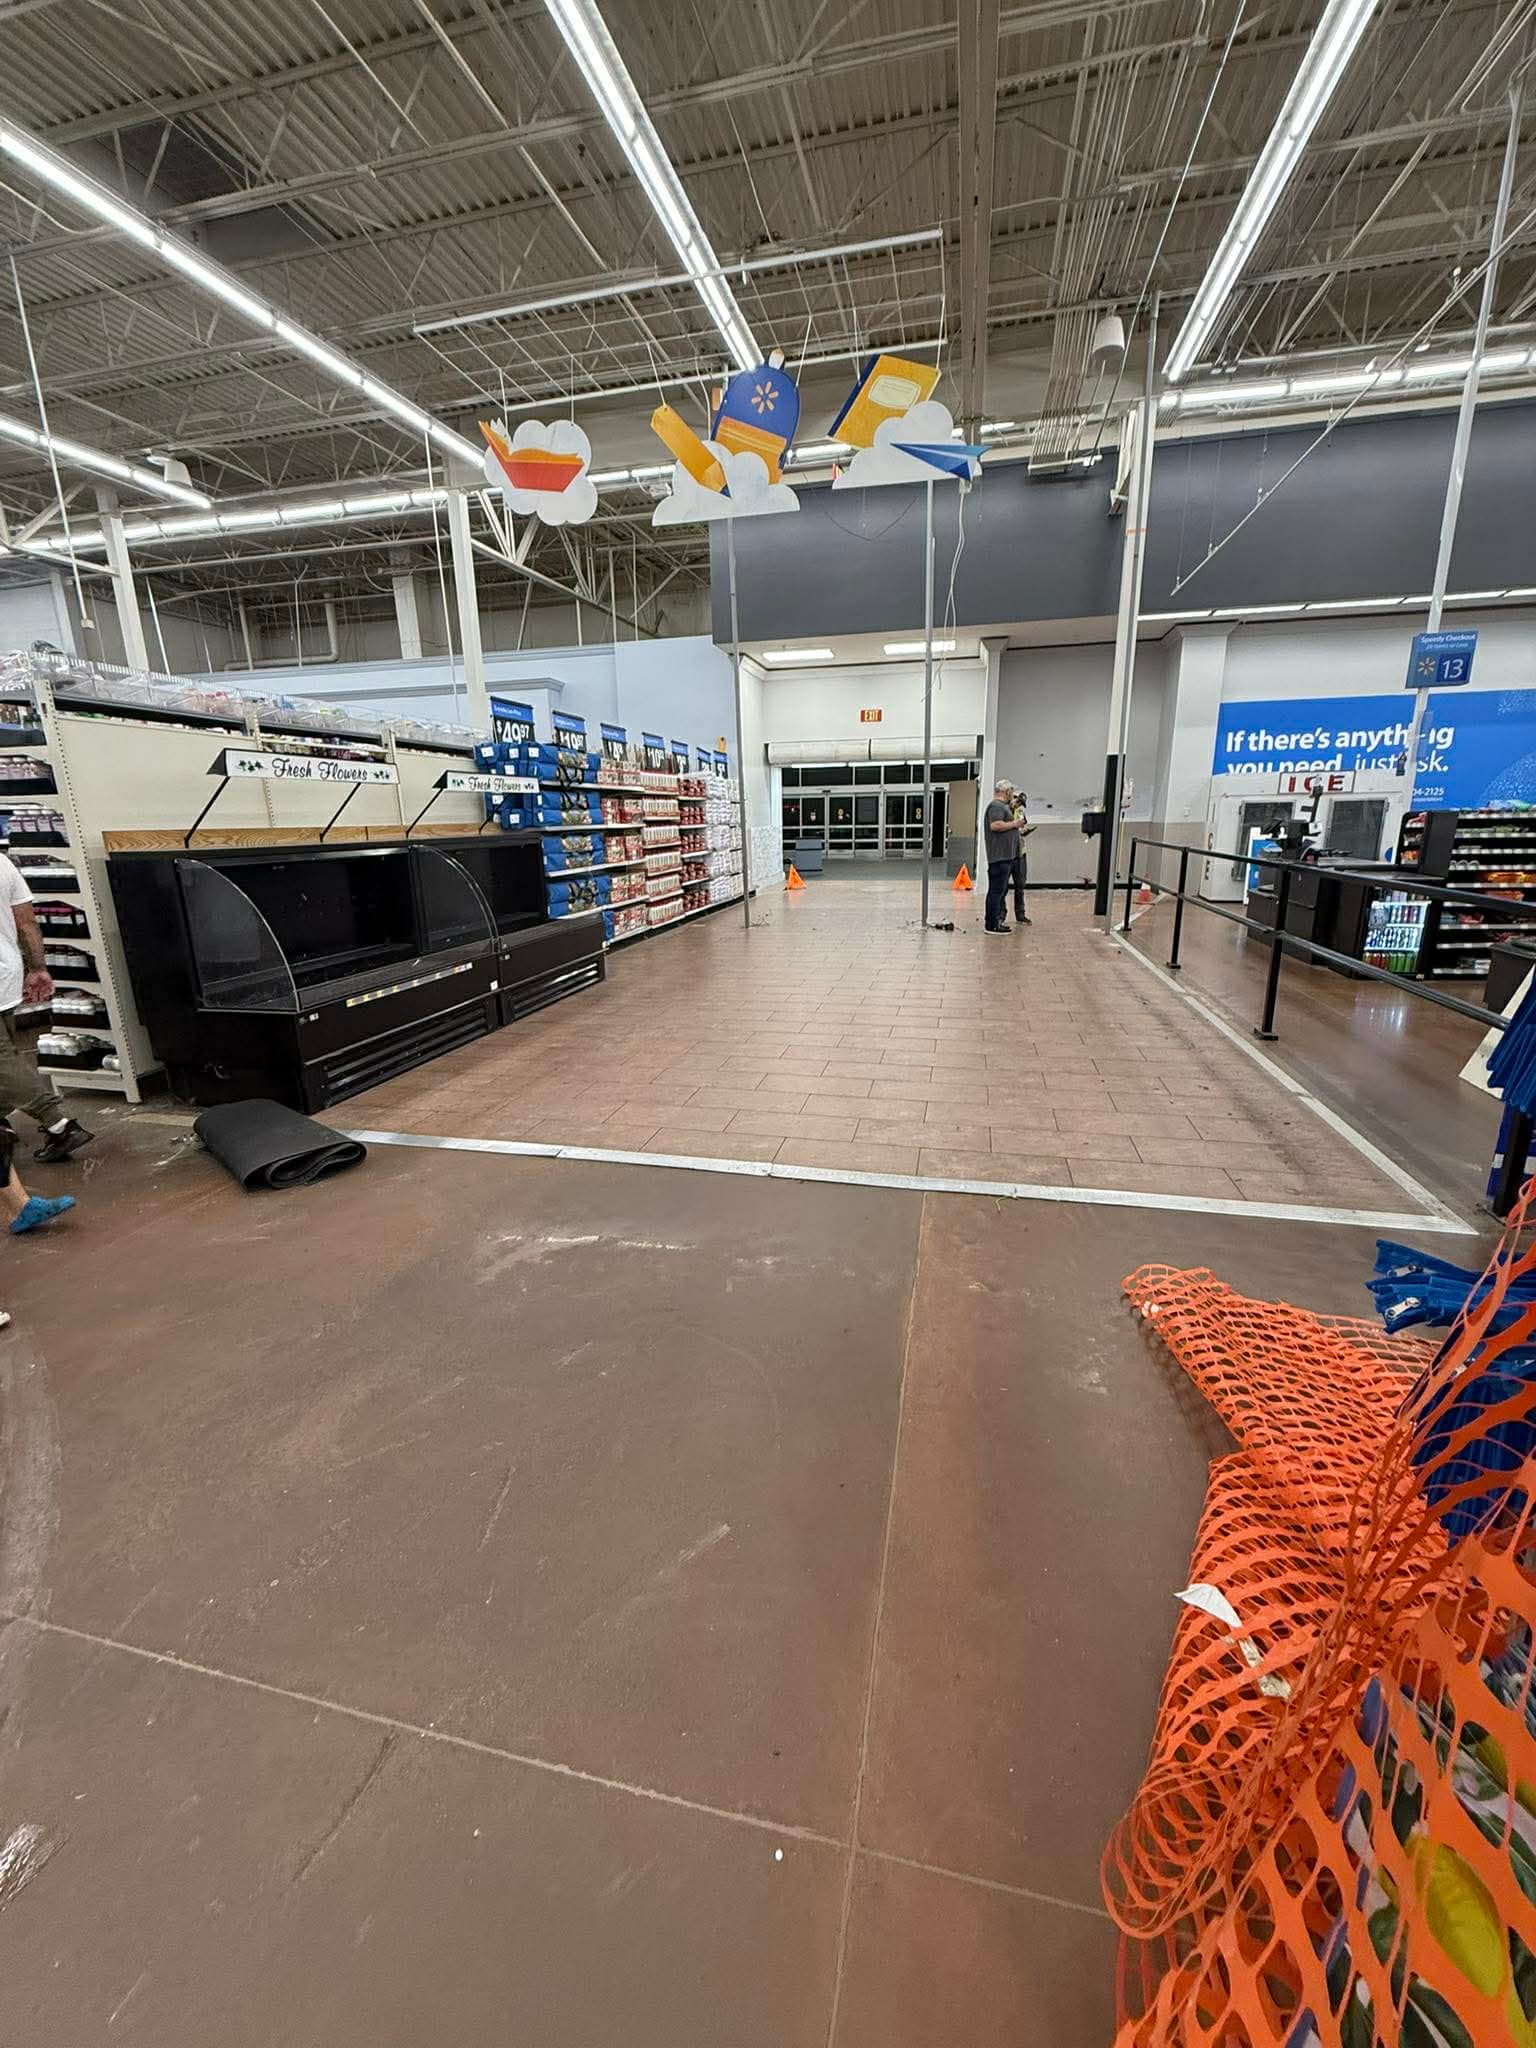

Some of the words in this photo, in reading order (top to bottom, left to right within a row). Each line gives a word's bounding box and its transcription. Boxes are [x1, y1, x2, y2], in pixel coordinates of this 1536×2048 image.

[1446, 633, 1476, 642] Checkout
[1443, 658, 1464, 679] 13
[864, 711, 879, 721] EXIT
[1226, 730, 1246, 752] If
[1247, 727, 1330, 751] there's
[271, 757, 312, 778] Fresh
[317, 761, 368, 781] Flowers
[1227, 762, 1274, 774] you
[468, 776, 491, 792] Fresh
[493, 777, 522, 792] Flowers
